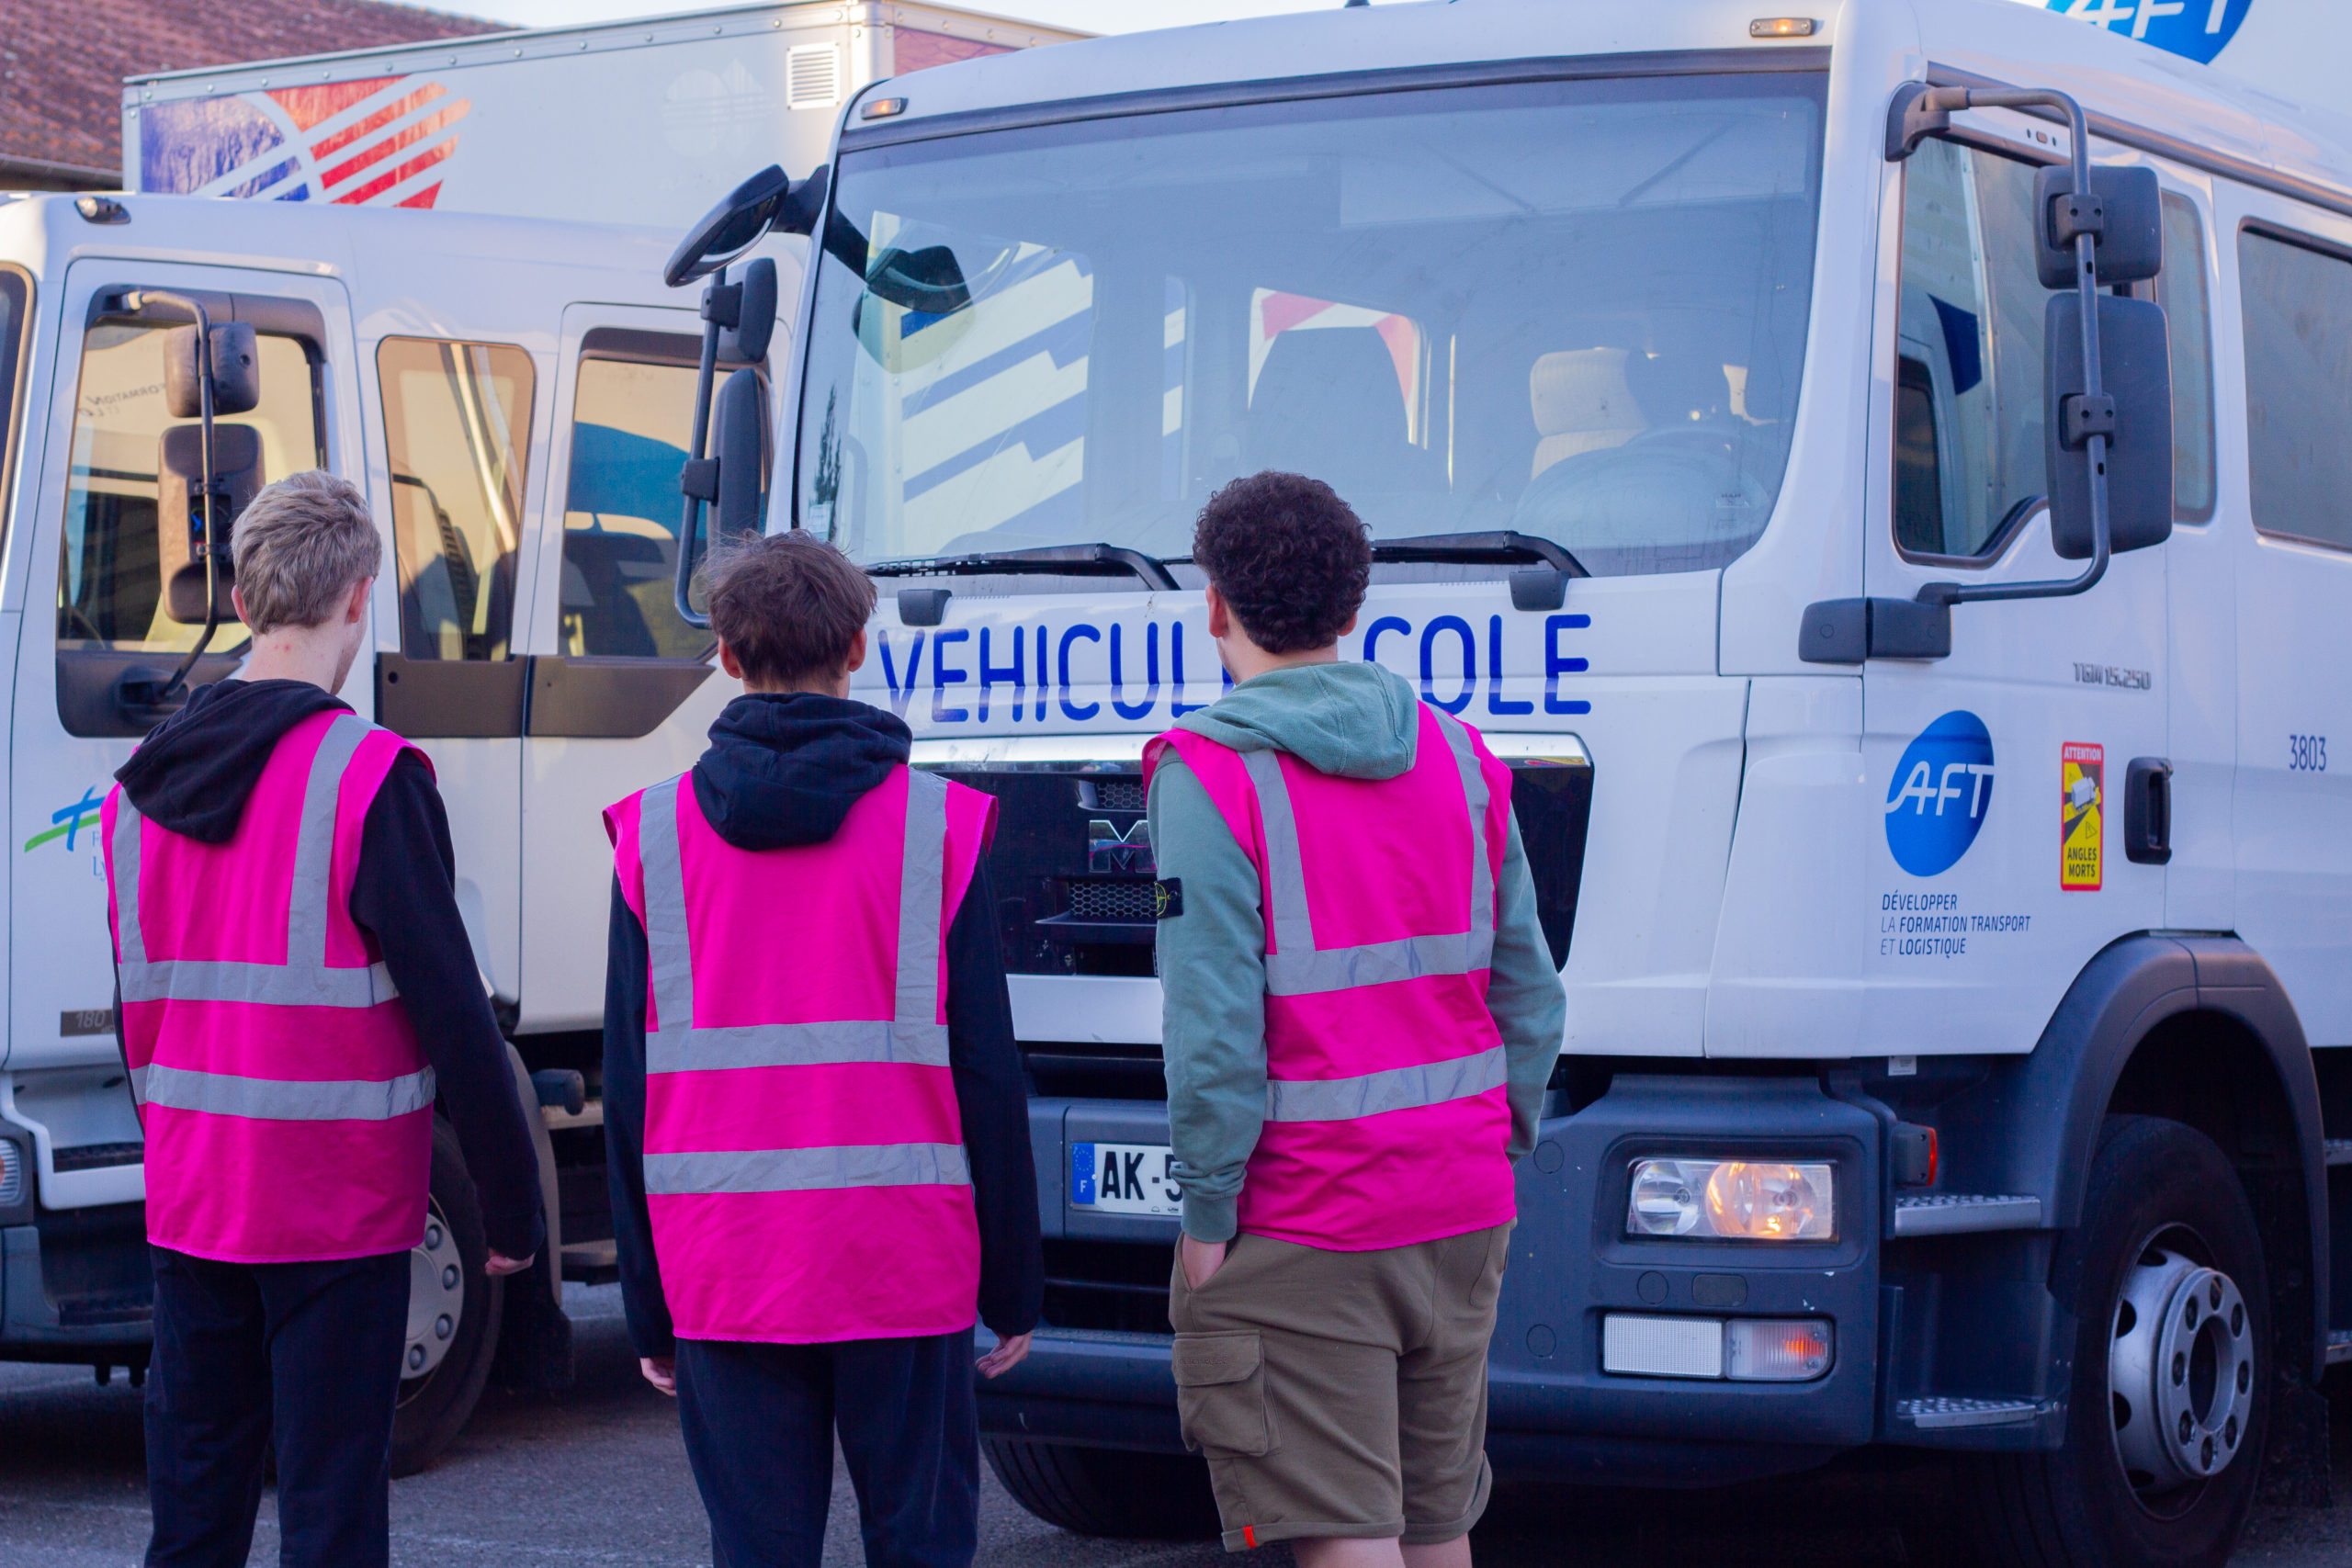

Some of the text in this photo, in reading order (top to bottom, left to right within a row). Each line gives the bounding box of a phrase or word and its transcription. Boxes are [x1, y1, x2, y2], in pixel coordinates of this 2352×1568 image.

[877, 615, 1591, 722] VEHICUL COLE
[2290, 734, 2326, 771] 3803
[1884, 761, 1995, 818] AFT
[2067, 846, 2097, 861] ANGLES
[2068, 863, 2096, 878] MORTS
[1882, 889, 1958, 910] DÉVELOPPER
[1881, 915, 2031, 933] LA FORMATION TRANSPORT
[1881, 937, 1967, 959] ET LOGISTIQUE
[1080, 1179, 1088, 1193] F
